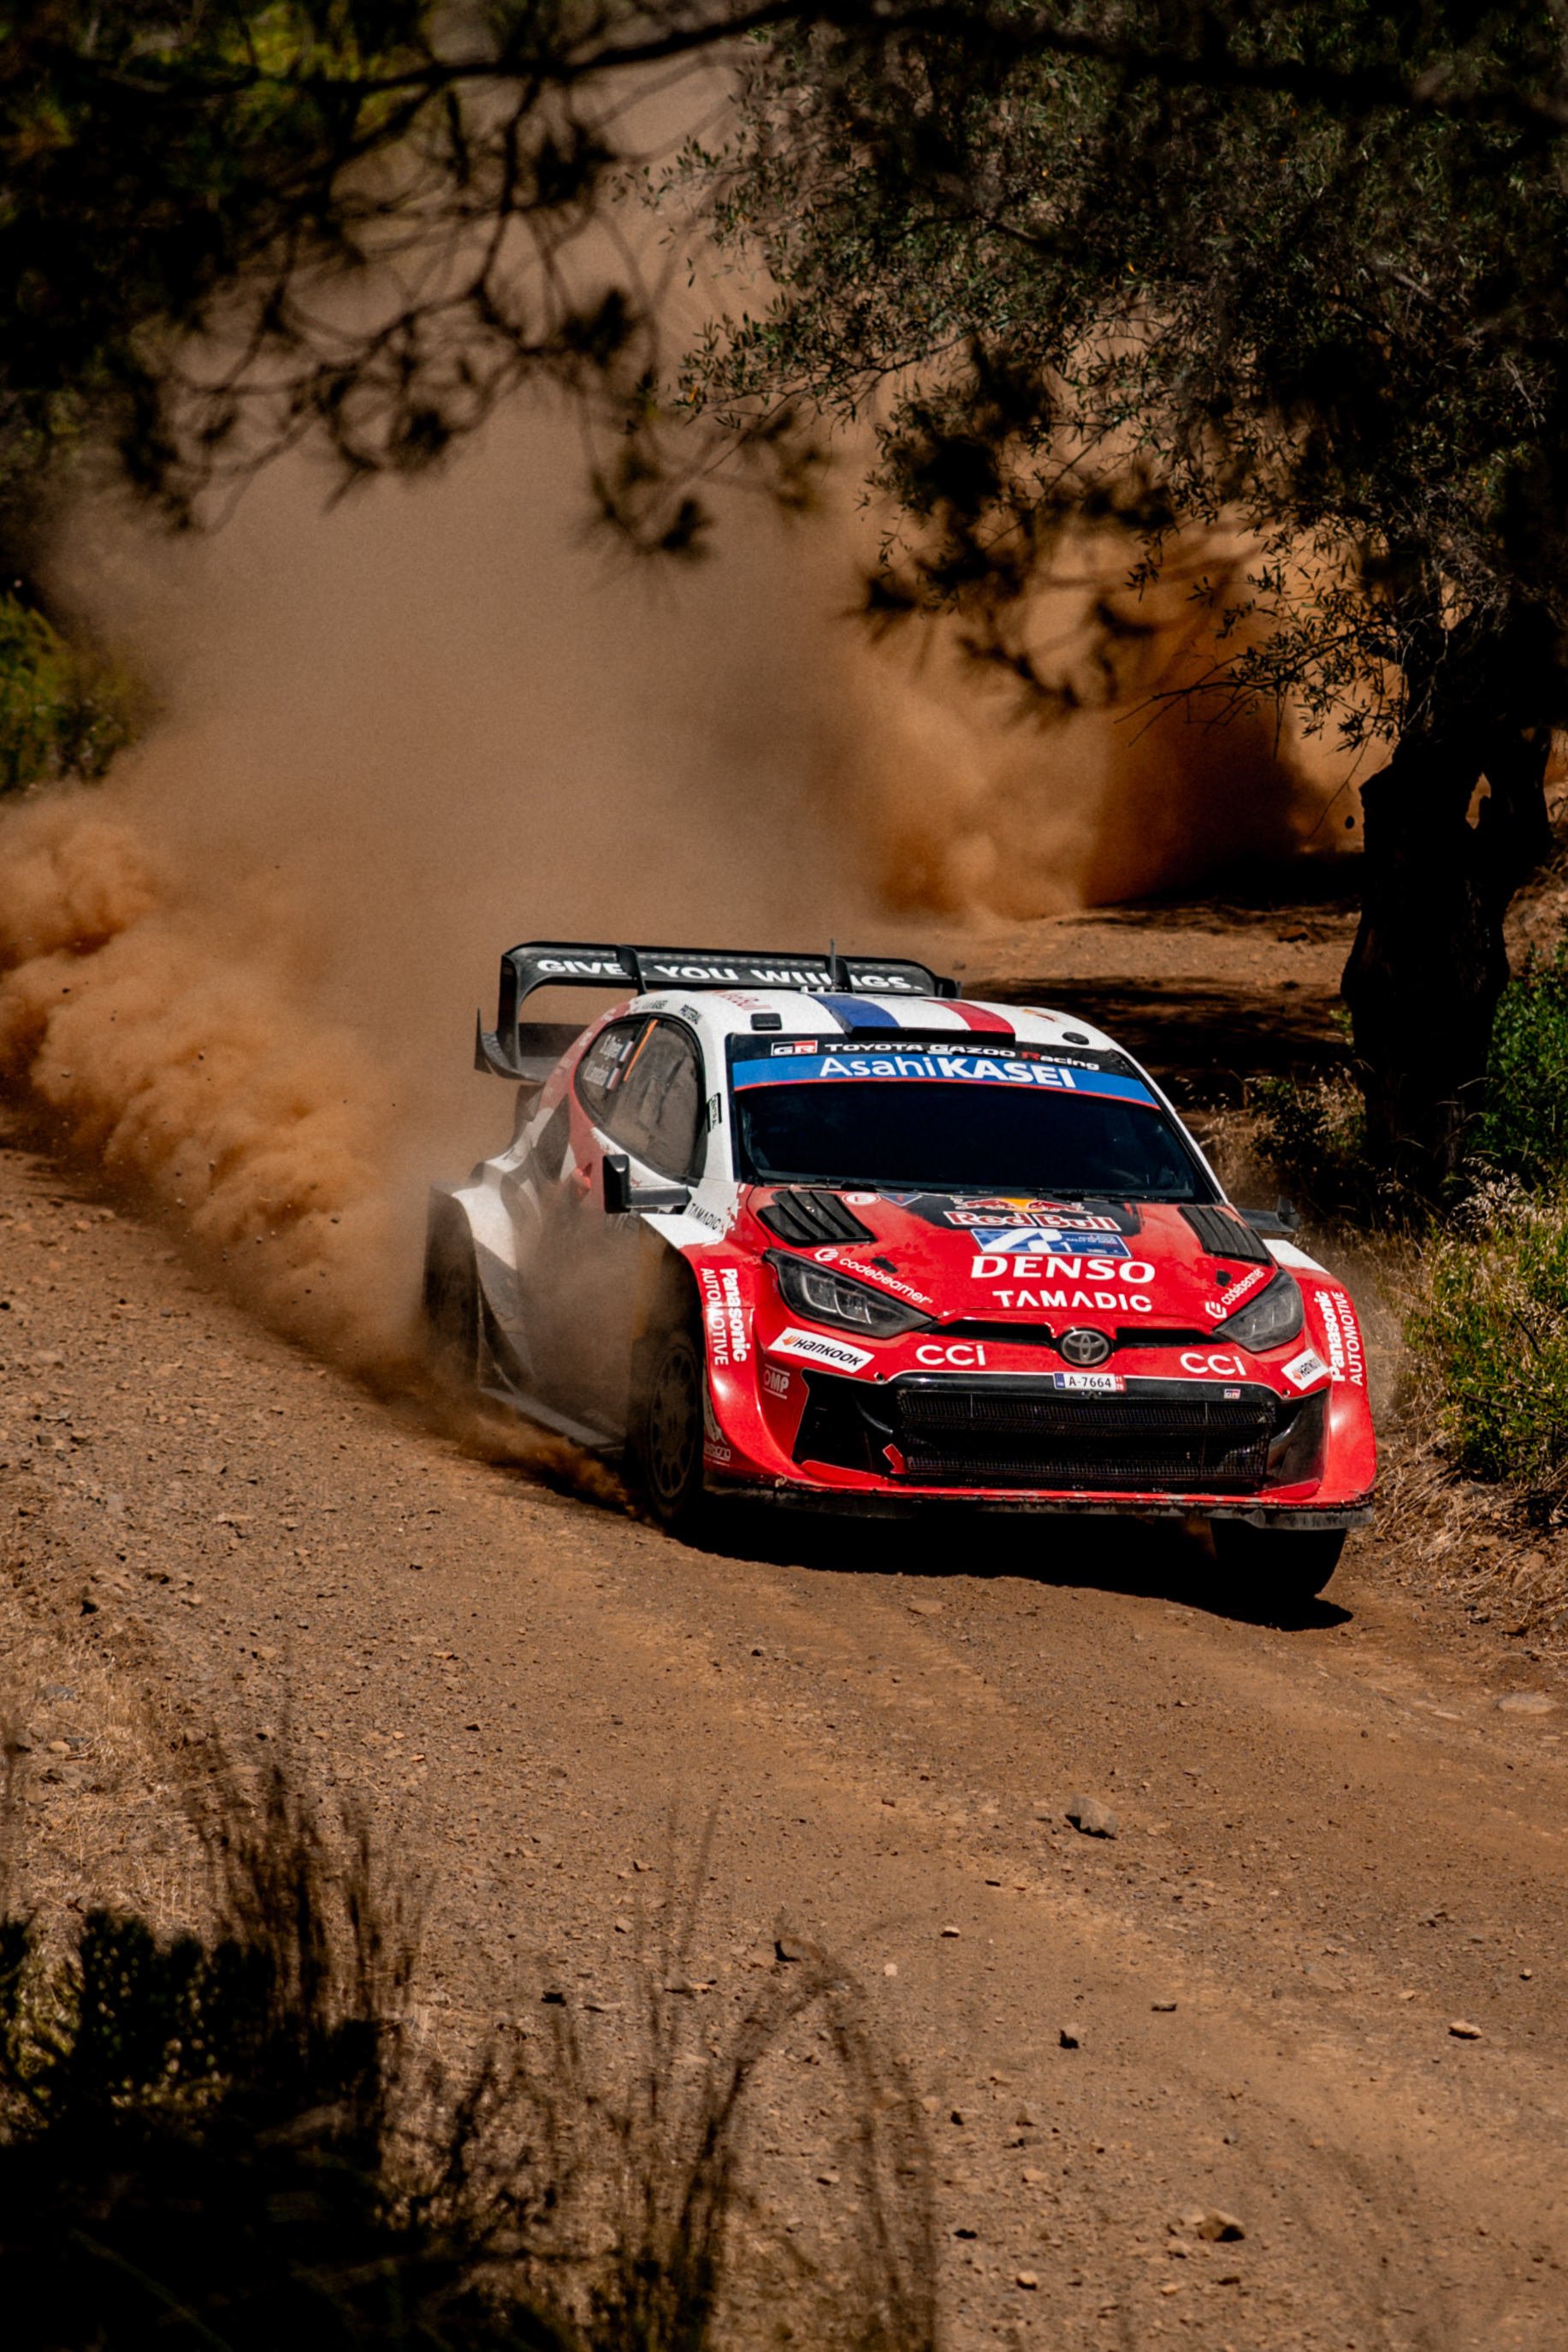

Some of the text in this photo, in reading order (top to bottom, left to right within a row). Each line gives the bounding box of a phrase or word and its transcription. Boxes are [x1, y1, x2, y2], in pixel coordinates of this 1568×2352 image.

[537, 959, 647, 976] GIVE
[654, 965, 739, 980] YOU
[773, 1042, 1099, 1070] GR TOYOTA GAZOO Racing
[820, 1056, 1077, 1087] AsahiKASEI
[688, 1203, 722, 1230] TAMADIC
[943, 1211, 1122, 1231] Red Bull
[1060, 1241, 1073, 1253] 1
[839, 1259, 931, 1303] codebeamer
[971, 1256, 1156, 1283] DENSO
[1222, 1267, 1265, 1306] codebeamer
[992, 1290, 1152, 1312] TAMADIC
[700, 1268, 729, 1366] AUTOMOTIVE
[719, 1268, 751, 1362] Panasonic
[1314, 1291, 1346, 1382] Panasonic
[1331, 1291, 1363, 1386] AUTOMOTIVE
[763, 1369, 790, 1394] OMP
[1068, 1376, 1112, 1388] A-7664
